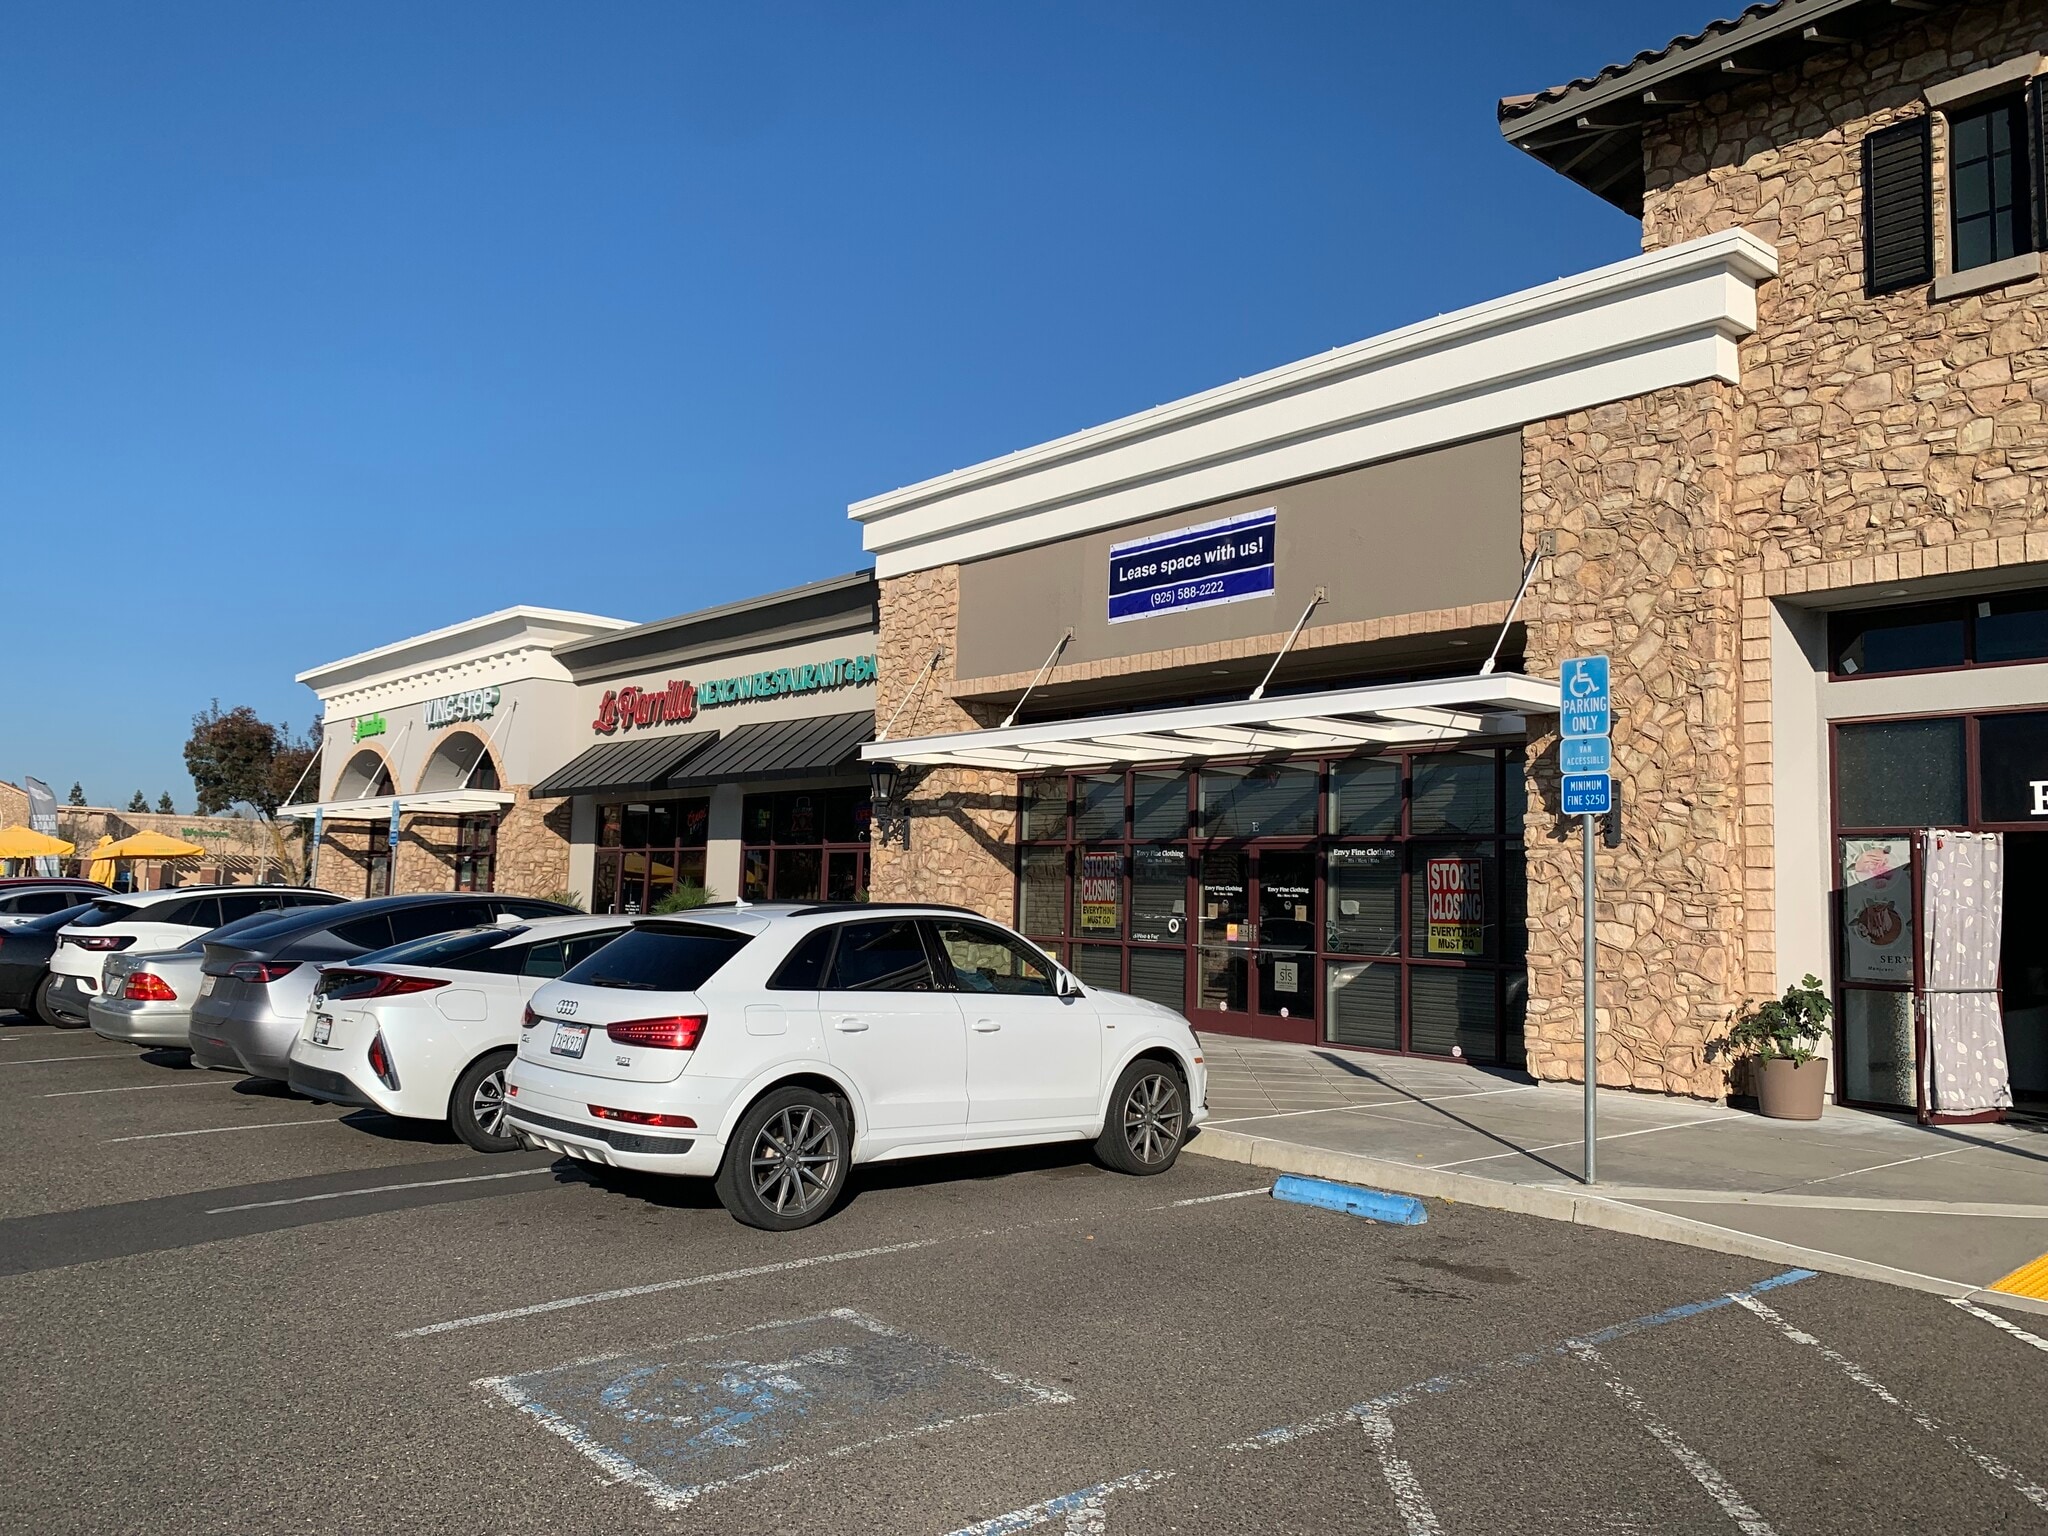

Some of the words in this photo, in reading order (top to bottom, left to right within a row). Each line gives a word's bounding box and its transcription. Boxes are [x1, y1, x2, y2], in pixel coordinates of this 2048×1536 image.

[1119, 562, 1157, 582] Lease
[1160, 553, 1201, 575] space
[1204, 544, 1236, 563] with
[1239, 536, 1264, 554] us!
[1150, 591, 1175, 607] (925)
[1177, 580, 1225, 600] 588-2222
[698, 673, 751, 706] MEXICAN
[752, 658, 846, 697] RESTAURANT
[591, 689, 616, 731] La
[619, 680, 695, 729] Parrilla
[1563, 696, 1607, 715] PARKING
[1572, 715, 1598, 732] ONLY
[1579, 745, 1592, 753] VAN
[1566, 756, 1604, 765] ACCESSIBLE
[1570, 780, 1602, 792] MINIMUM
[1567, 795, 1583, 806] FINE
[1585, 793, 1606, 807] $250
[1252, 821, 1260, 831] E
[1162, 849, 1184, 858] Clothing
[1333, 848, 1350, 857] Envy
[1351, 848, 1366, 856] Fine
[1366, 848, 1395, 857] Clothing
[1084, 856, 1115, 877] STORE
[1431, 863, 1480, 890] STORE
[1083, 880, 1115, 902] CLOSING
[1290, 886, 1309, 894] Clothing
[1083, 906, 1115, 915] EVERYTHING
[1431, 893, 1481, 921] CLOSING
[1087, 916, 1102, 924] MUST
[1103, 916, 1110, 924] GO
[1431, 925, 1482, 938] EVERYTHING
[1438, 938, 1461, 950] MUST
[1462, 939, 1474, 950] GO
